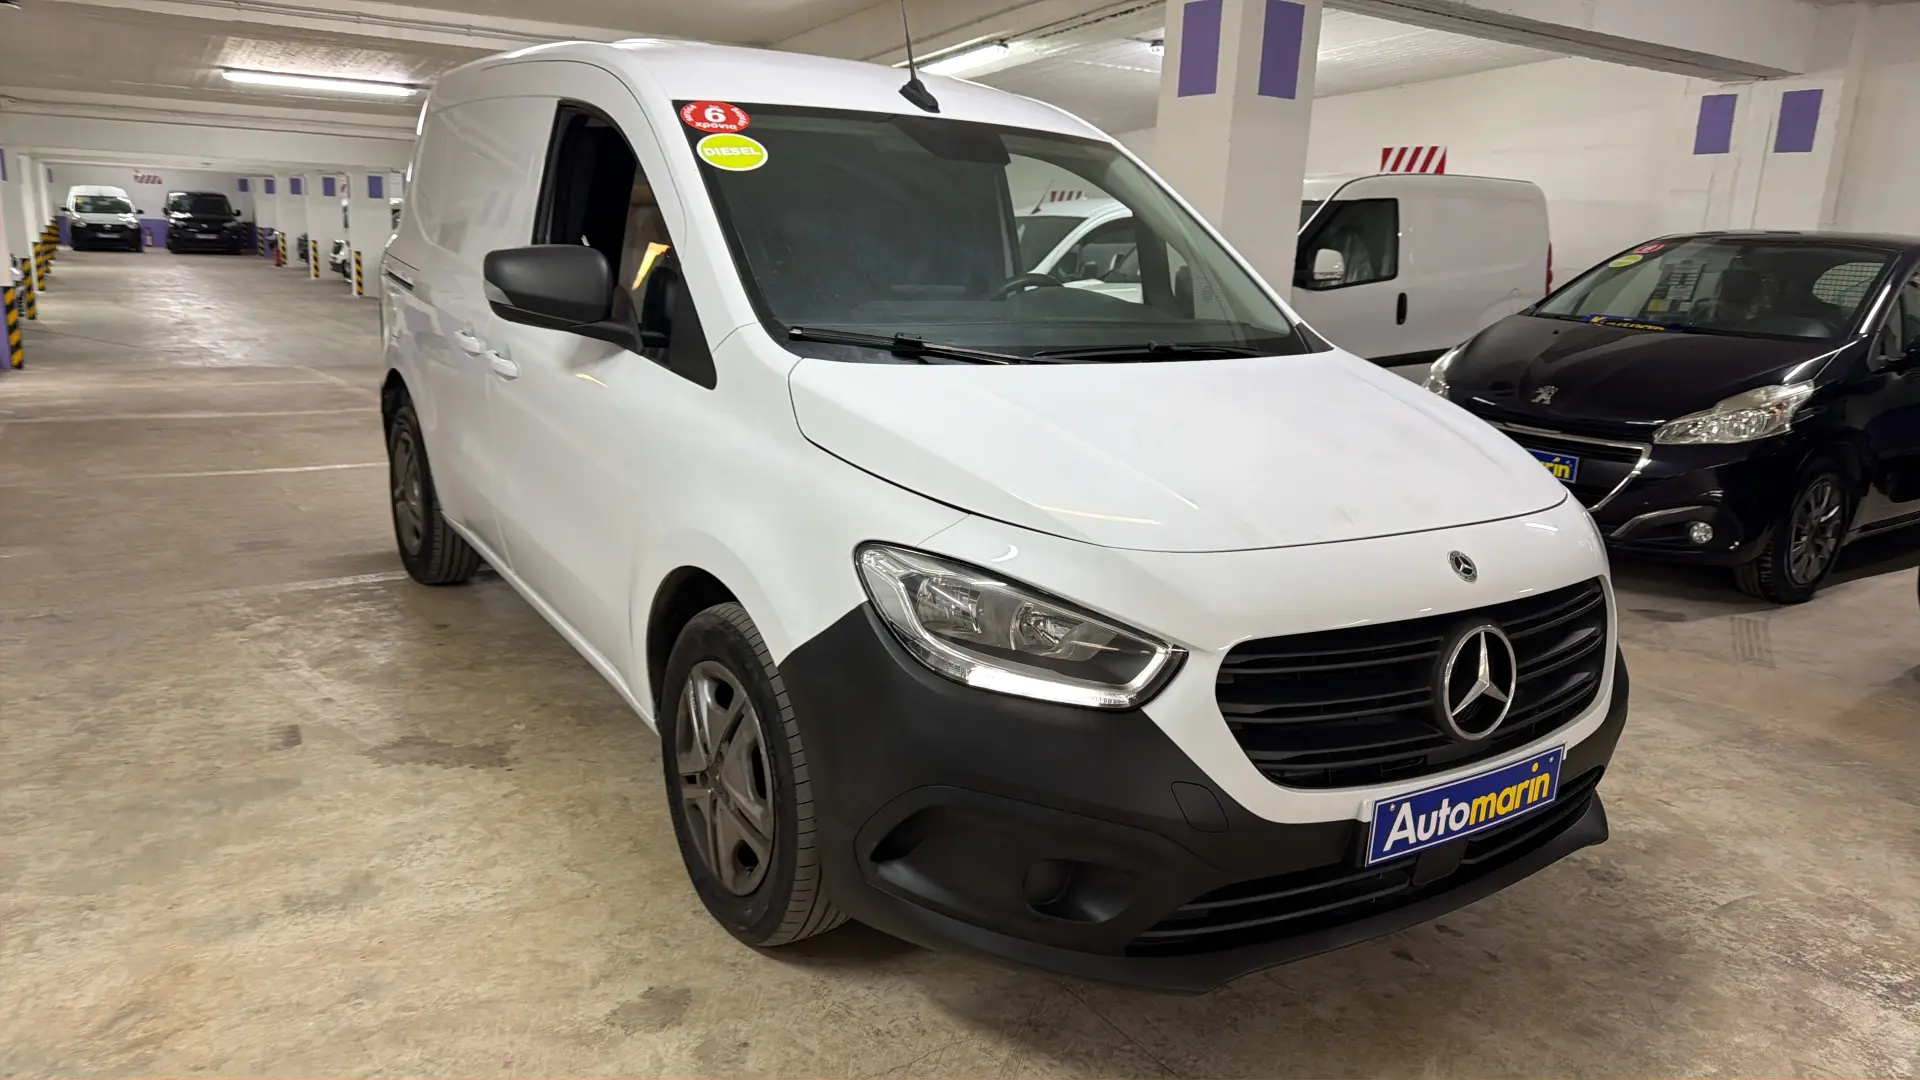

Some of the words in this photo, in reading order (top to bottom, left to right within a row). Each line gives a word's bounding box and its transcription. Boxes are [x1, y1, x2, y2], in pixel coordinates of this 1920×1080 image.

[704, 107, 726, 123] 6
[703, 147, 761, 156] DIESEL
[1383, 762, 1550, 852] Automarin
